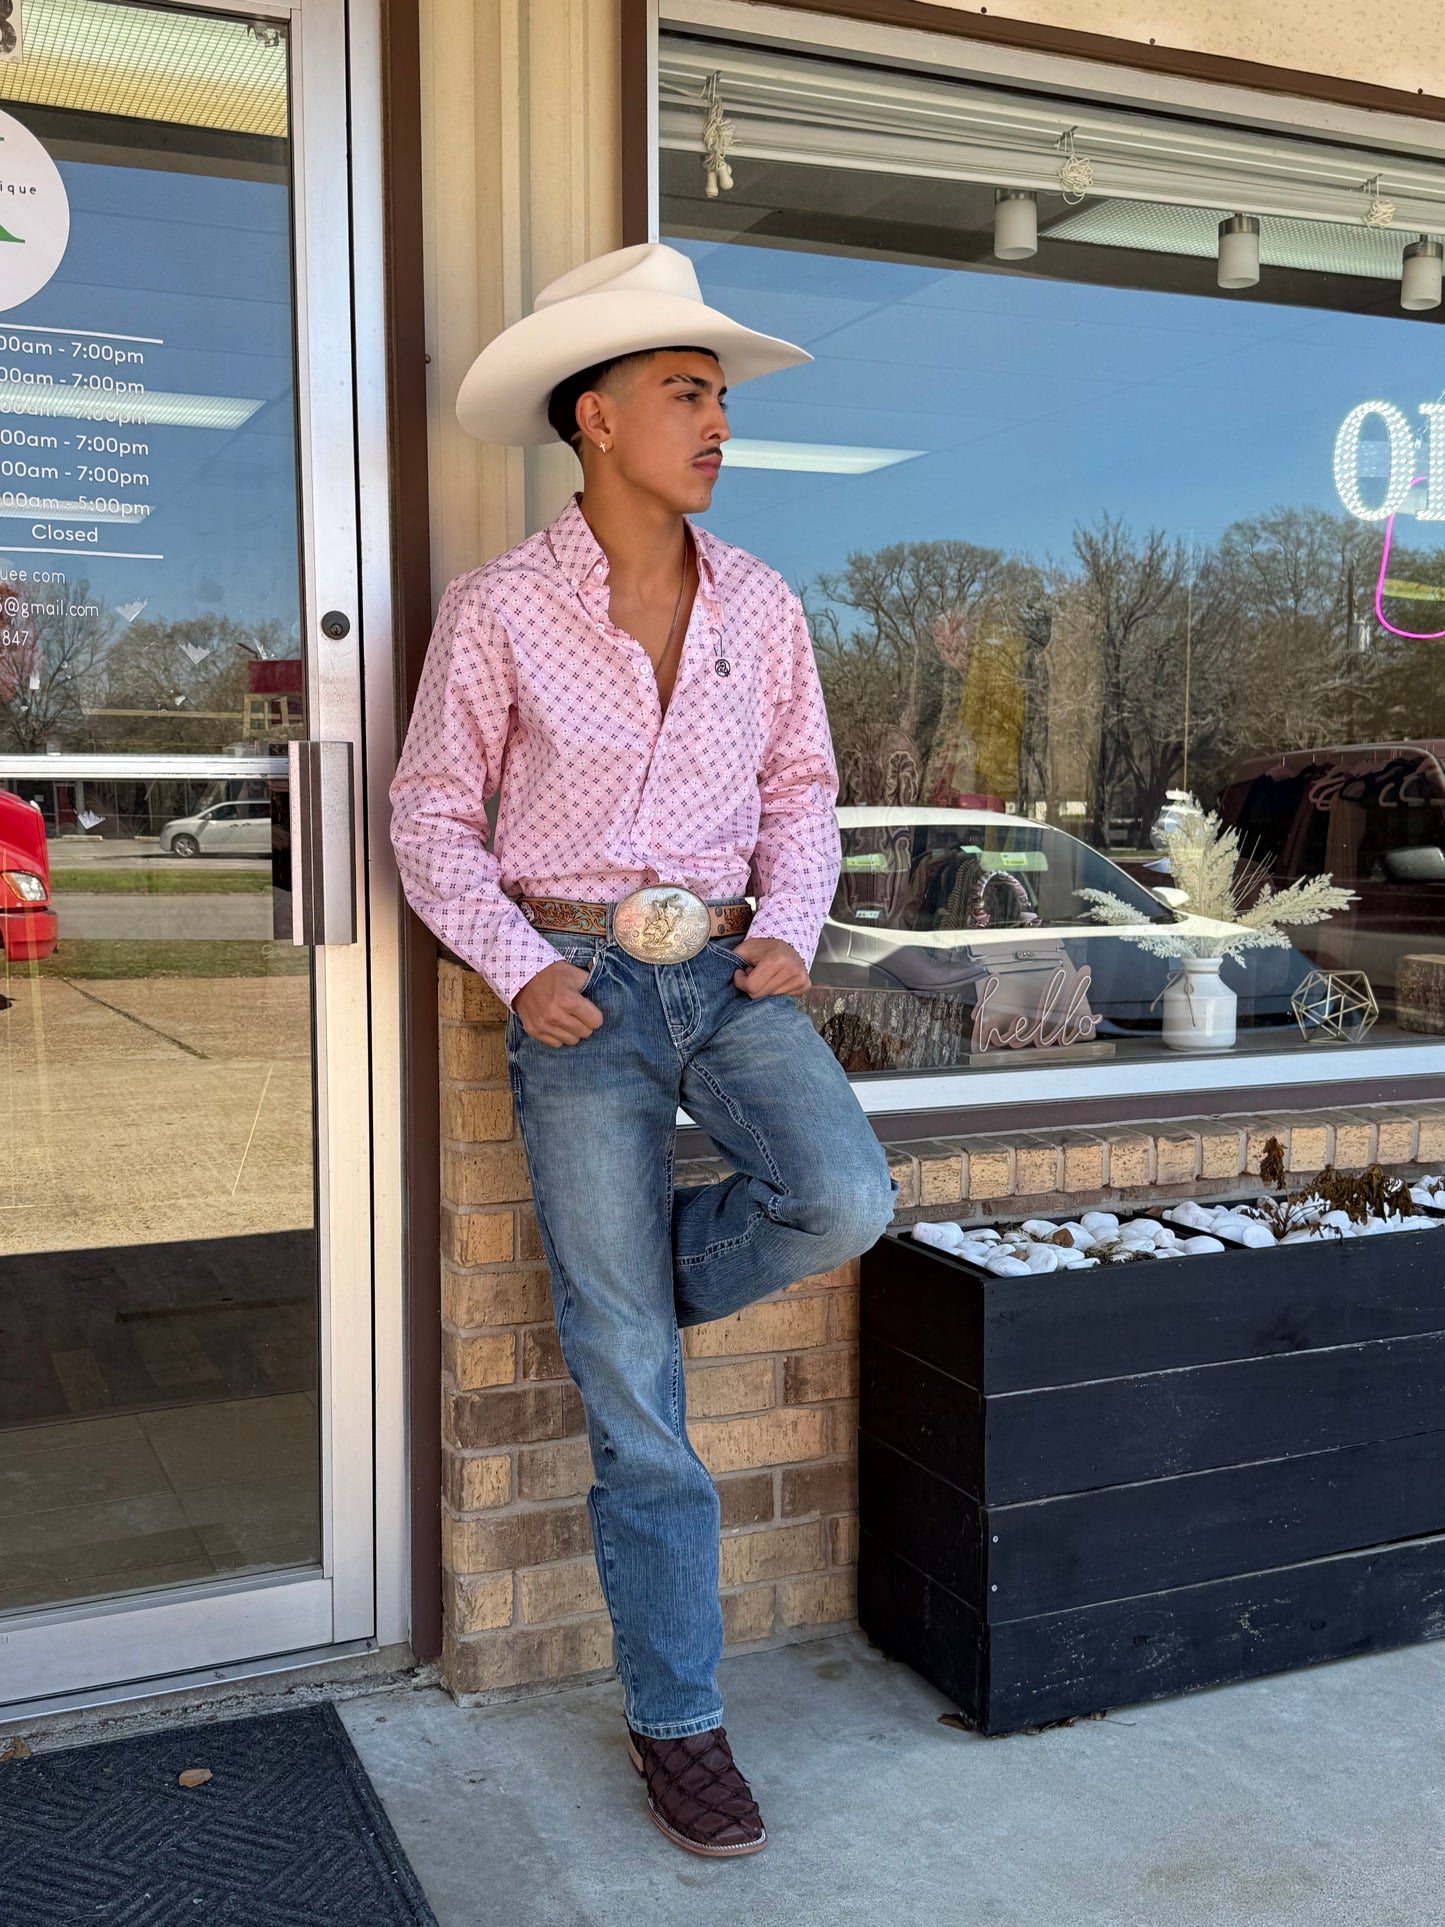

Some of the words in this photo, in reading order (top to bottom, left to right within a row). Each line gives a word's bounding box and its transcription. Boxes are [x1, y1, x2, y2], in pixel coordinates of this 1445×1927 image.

[71, 342, 144, 365] 7:00pm
[71, 373, 145, 395] 7:00pm
[75, 404, 148, 427] 7:00pm
[76, 435, 149, 457] 7:00pm
[77, 466, 149, 488] 7:00pm
[78, 496, 150, 517] 5:00pm
[31, 524, 99, 542] Closed
[0, 595, 99, 618] @gmail.com
[2, 629, 29, 646] 847
[974, 967, 1103, 1053] hello
